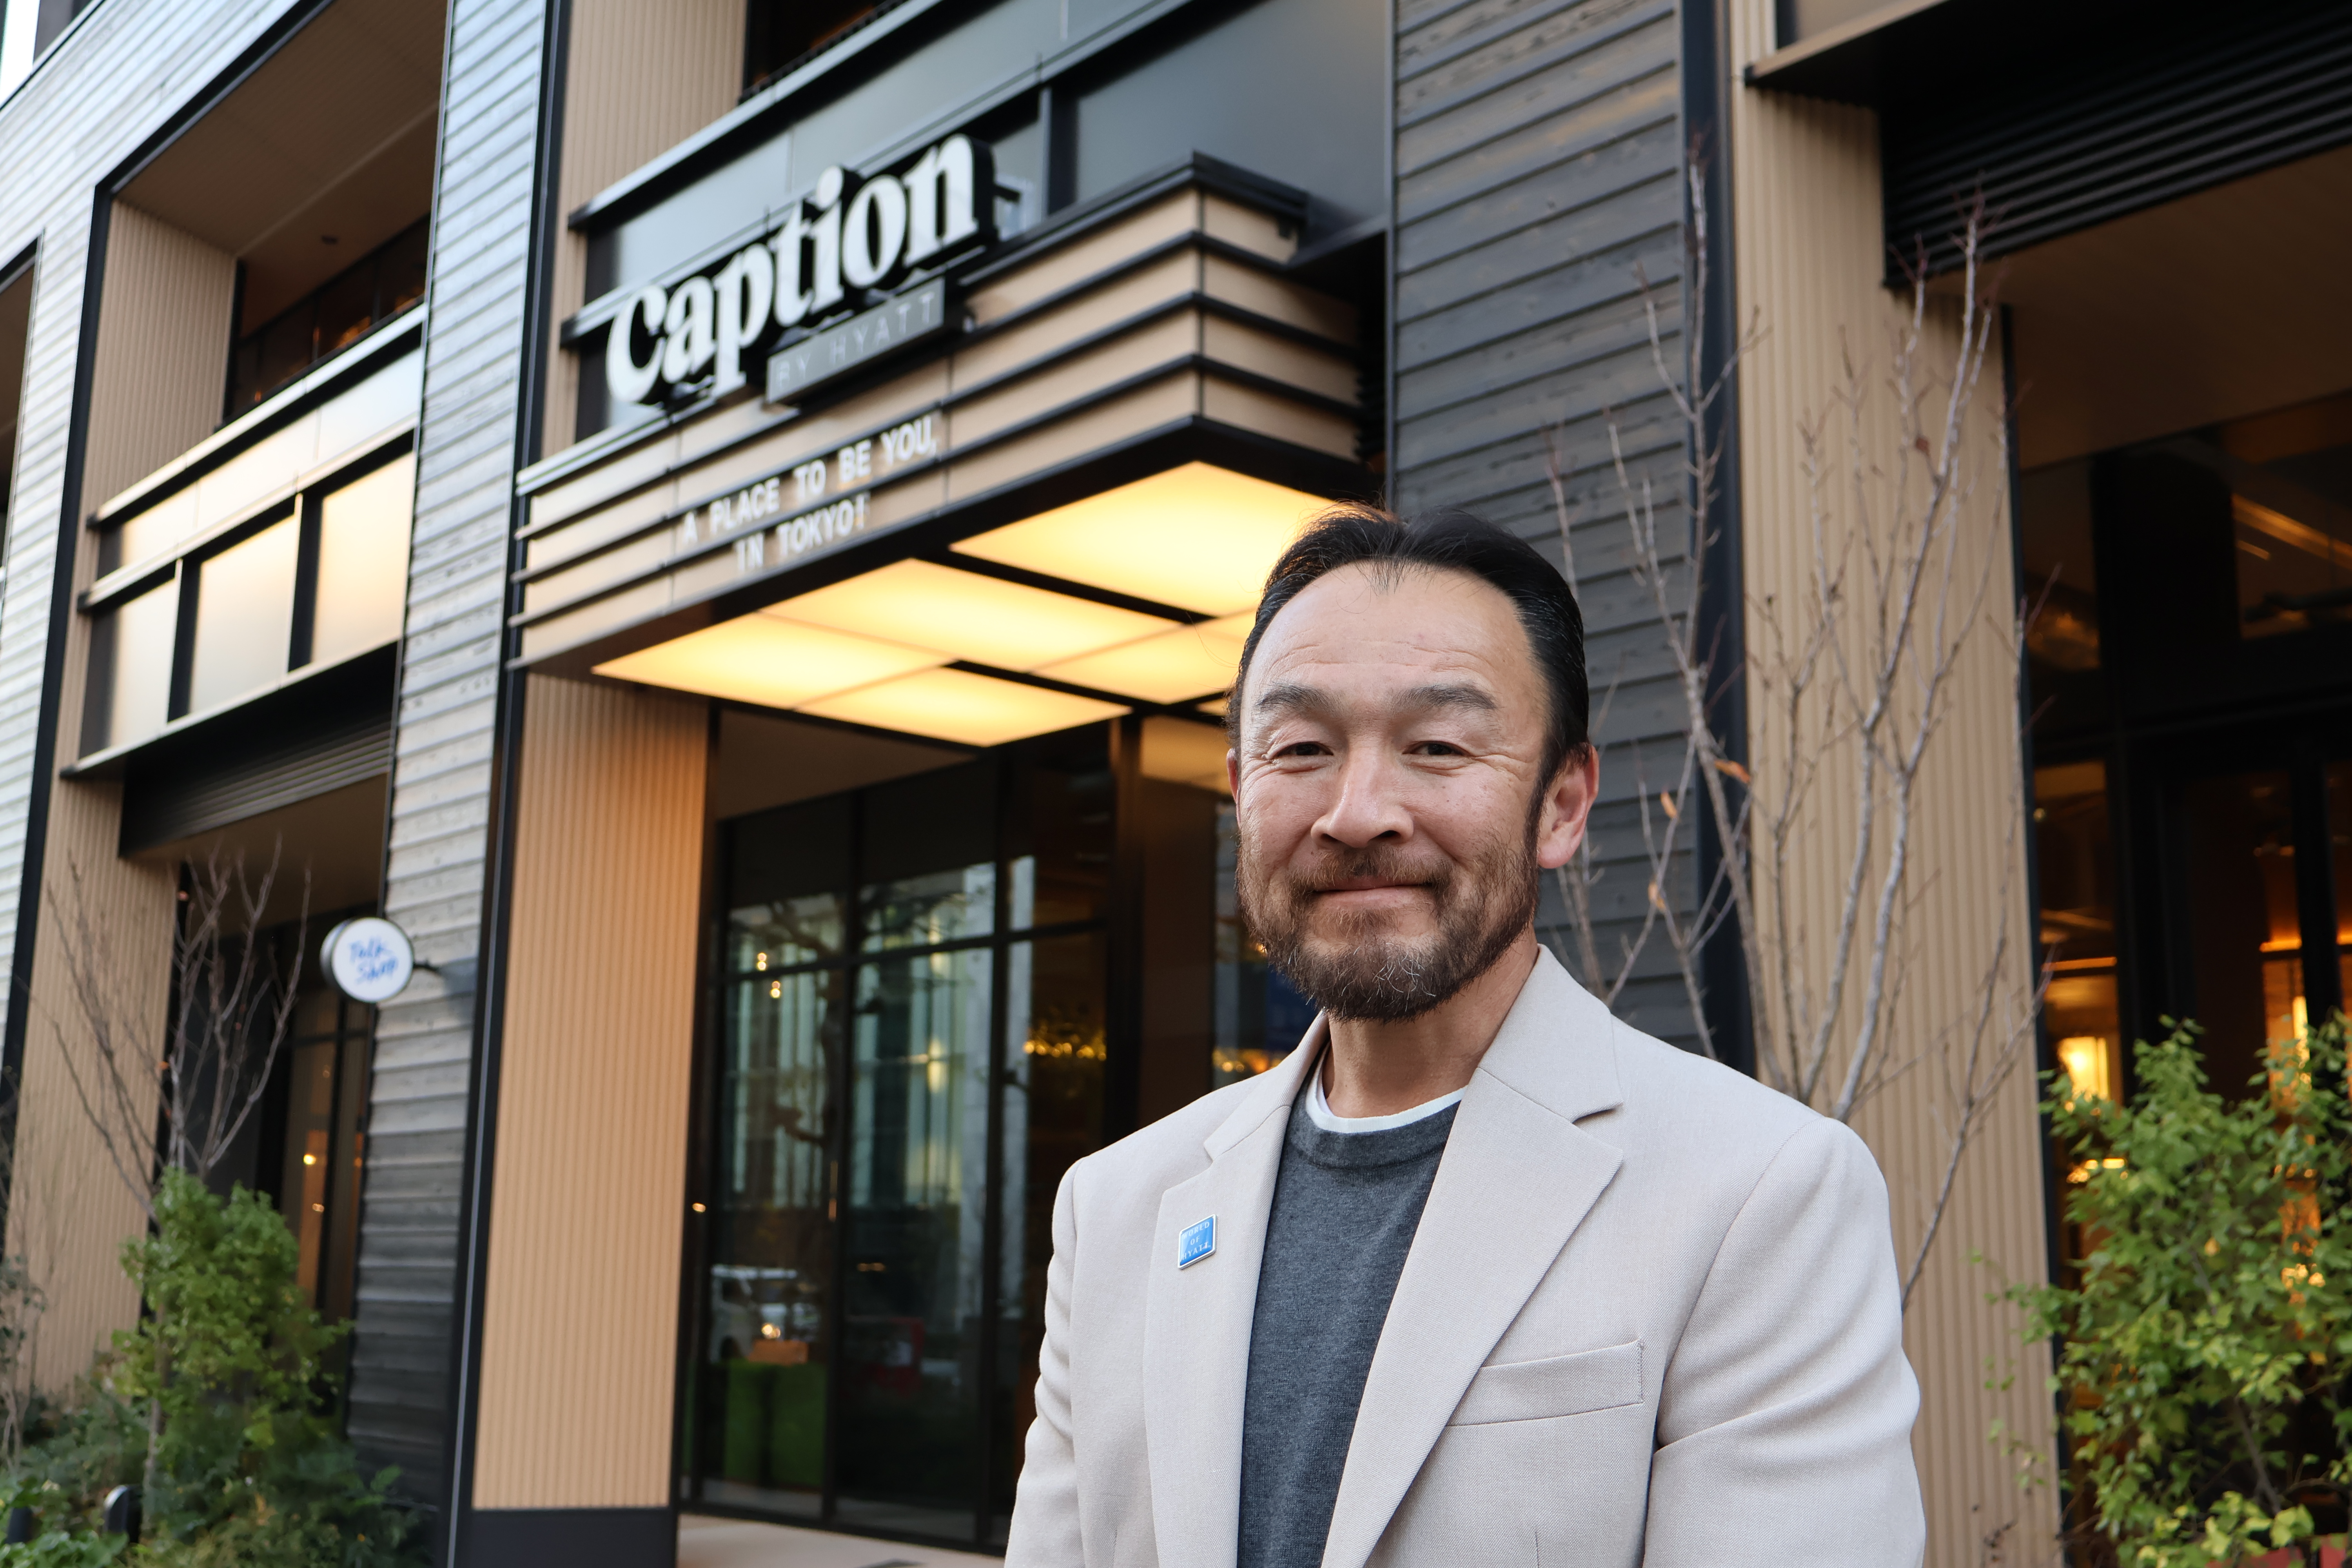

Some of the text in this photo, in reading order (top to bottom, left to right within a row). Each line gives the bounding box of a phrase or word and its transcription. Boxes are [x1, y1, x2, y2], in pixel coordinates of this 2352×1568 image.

[606, 134, 978, 404] Caption
[776, 292, 935, 388] BY HYATT
[683, 415, 936, 545] A PLACE TO BE YOU,
[734, 530, 764, 572] IN
[1181, 1241, 1209, 1260] HYATT
[1182, 1221, 1209, 1240] WORLD
[1190, 1236, 1200, 1245] OF
